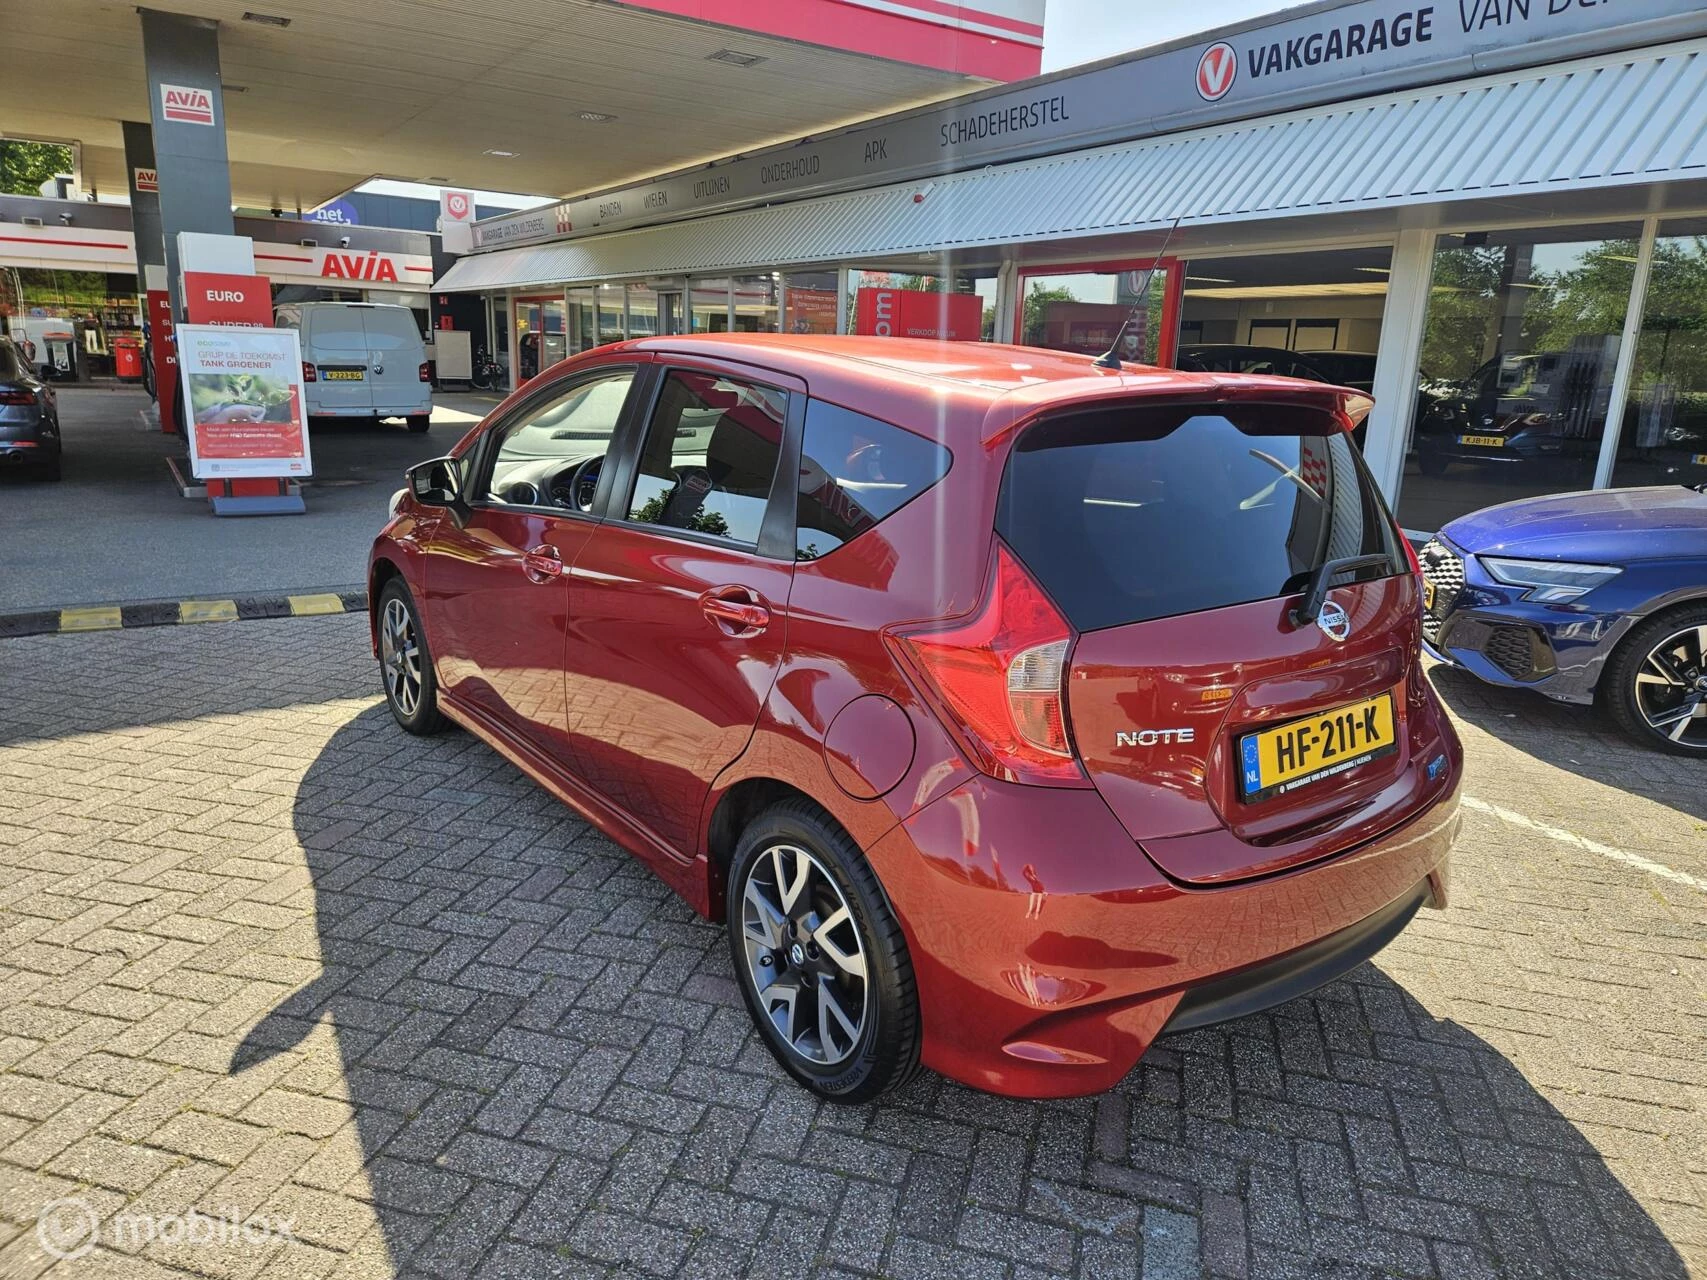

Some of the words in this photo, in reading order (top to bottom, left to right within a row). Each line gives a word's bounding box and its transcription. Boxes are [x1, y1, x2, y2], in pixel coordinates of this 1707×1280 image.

[1248, 7, 1434, 78] VAKGARAGE
[165, 90, 210, 109] AVIA
[940, 96, 1070, 147] SCHADEHERSTEL
[864, 138, 888, 163] APK
[761, 155, 820, 184] ONDERHOUD
[693, 175, 730, 199] UITLIJNEN
[600, 201, 622, 218] BANDEN
[643, 191, 668, 209] WIELEN
[321, 248, 398, 283] AVIA
[206, 289, 245, 303] EURO
[200, 359, 224, 368] TANK
[226, 360, 272, 369] GROENER
[1116, 727, 1195, 747] NOTE
[1276, 705, 1380, 773] HF-211-K
[1246, 770, 1259, 785] NL
